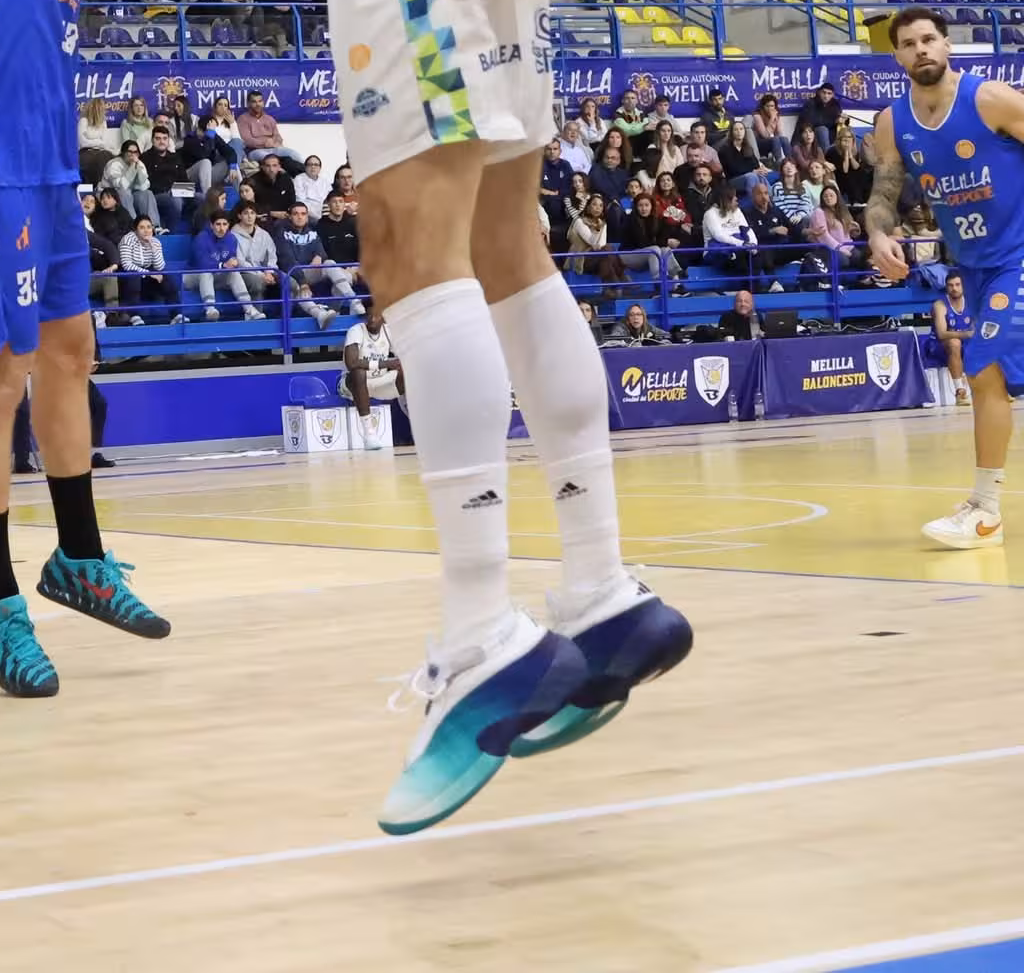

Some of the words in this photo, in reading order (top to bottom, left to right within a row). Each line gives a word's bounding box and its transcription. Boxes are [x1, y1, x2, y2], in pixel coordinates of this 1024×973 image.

[74, 71, 134, 100] LILLA
[194, 79, 226, 88] CIUDAD
[228, 76, 280, 88] AUTÓNOMA
[660, 75, 689, 84] CIUDAD
[752, 64, 827, 91] MELILLA
[954, 212, 988, 240] 22
[810, 356, 855, 373] MELILLA
[802, 372, 867, 391] BALONCESTO
[647, 388, 688, 402] DEPORTE
